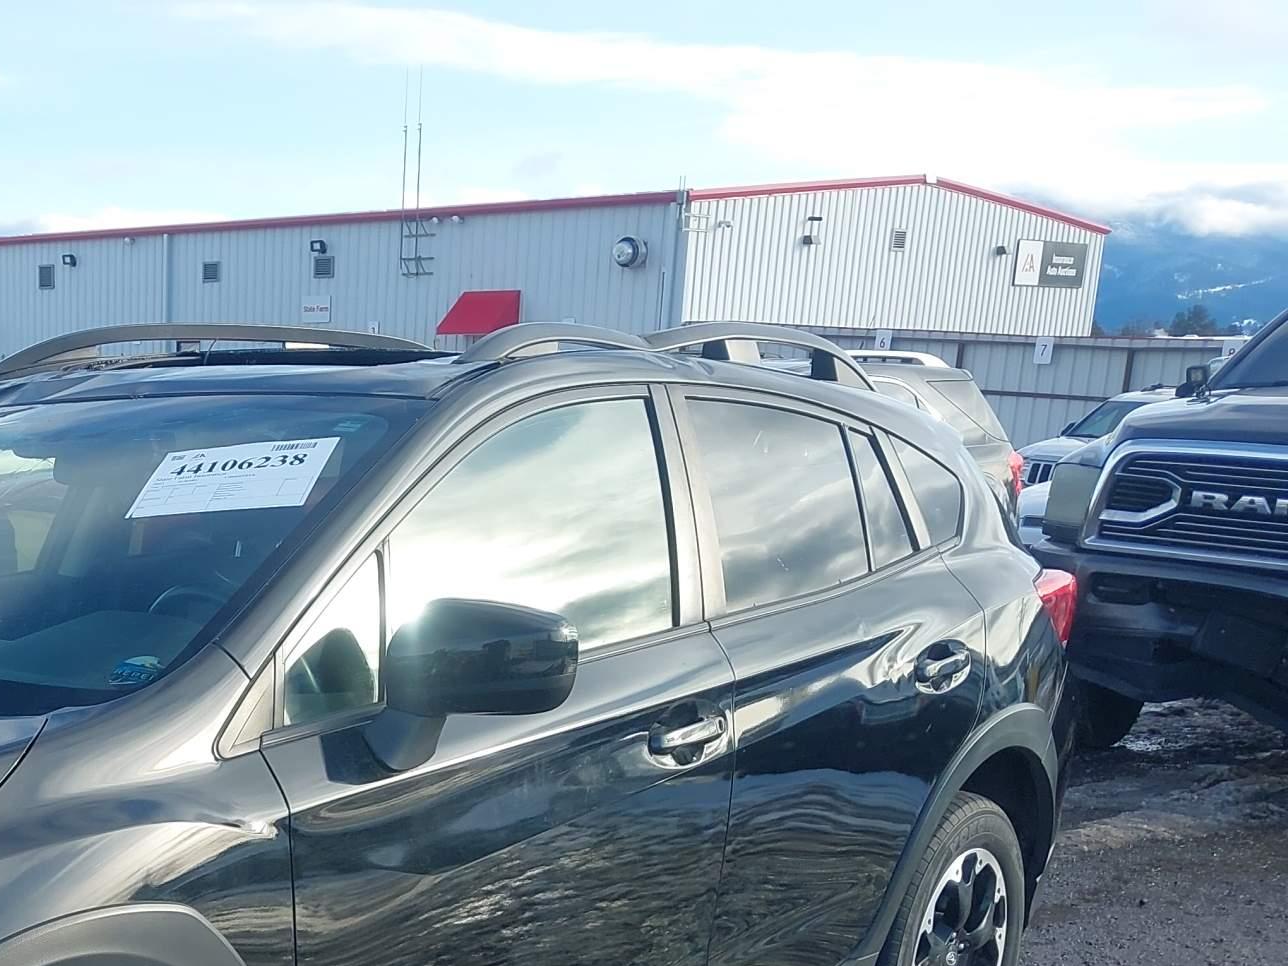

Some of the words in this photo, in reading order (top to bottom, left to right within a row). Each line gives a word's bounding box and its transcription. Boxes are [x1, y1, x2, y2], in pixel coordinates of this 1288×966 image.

[879, 337, 886, 349] 6
[1040, 343, 1048, 357] 7
[170, 453, 308, 476] 44106238
